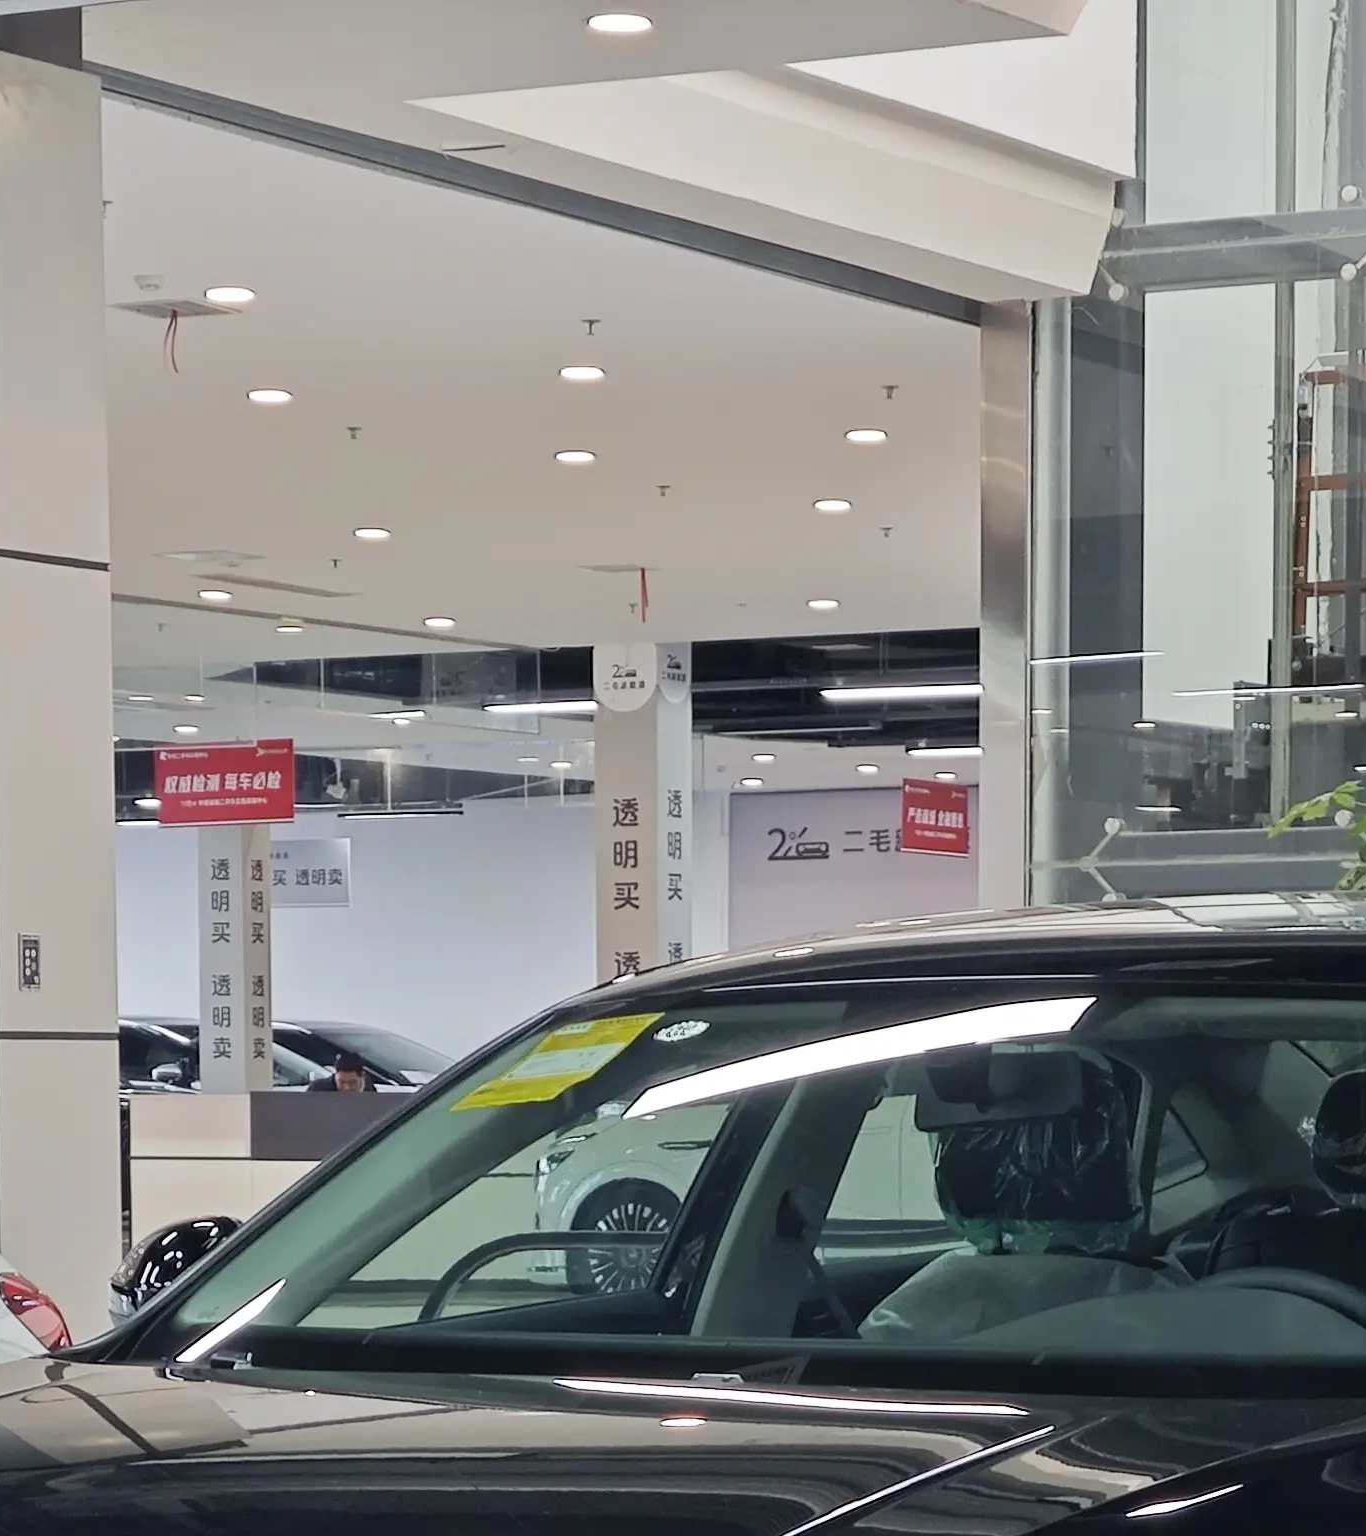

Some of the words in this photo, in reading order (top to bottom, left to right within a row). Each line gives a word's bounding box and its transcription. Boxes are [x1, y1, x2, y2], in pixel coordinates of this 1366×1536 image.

[295, 868, 344, 886] 透明卖
[612, 797, 640, 910] 透明买
[667, 789, 683, 901] 透明买
[210, 858, 231, 943] 透明买
[251, 859, 265, 944] 透明买
[212, 974, 232, 1059] 透明卖
[252, 975, 266, 1060] 透明卖
